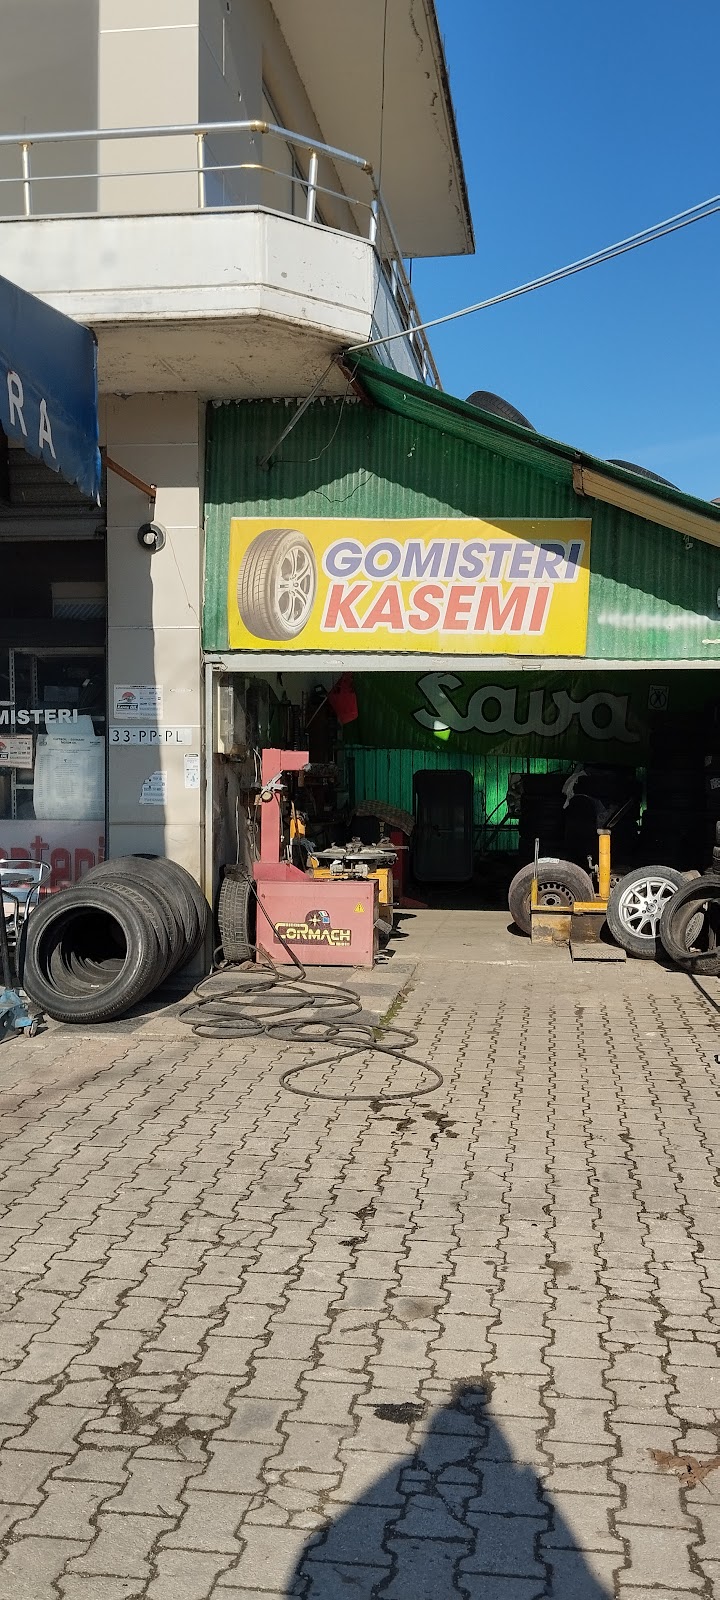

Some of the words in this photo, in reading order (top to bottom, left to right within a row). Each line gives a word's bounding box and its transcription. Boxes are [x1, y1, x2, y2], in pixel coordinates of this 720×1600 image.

[324, 541, 583, 580] GOMISTERI
[323, 583, 551, 632] KASEMI
[413, 672, 640, 743] Sava
[112, 730, 183, 742] 33-PP-PL
[274, 922, 351, 946] CORMACH
